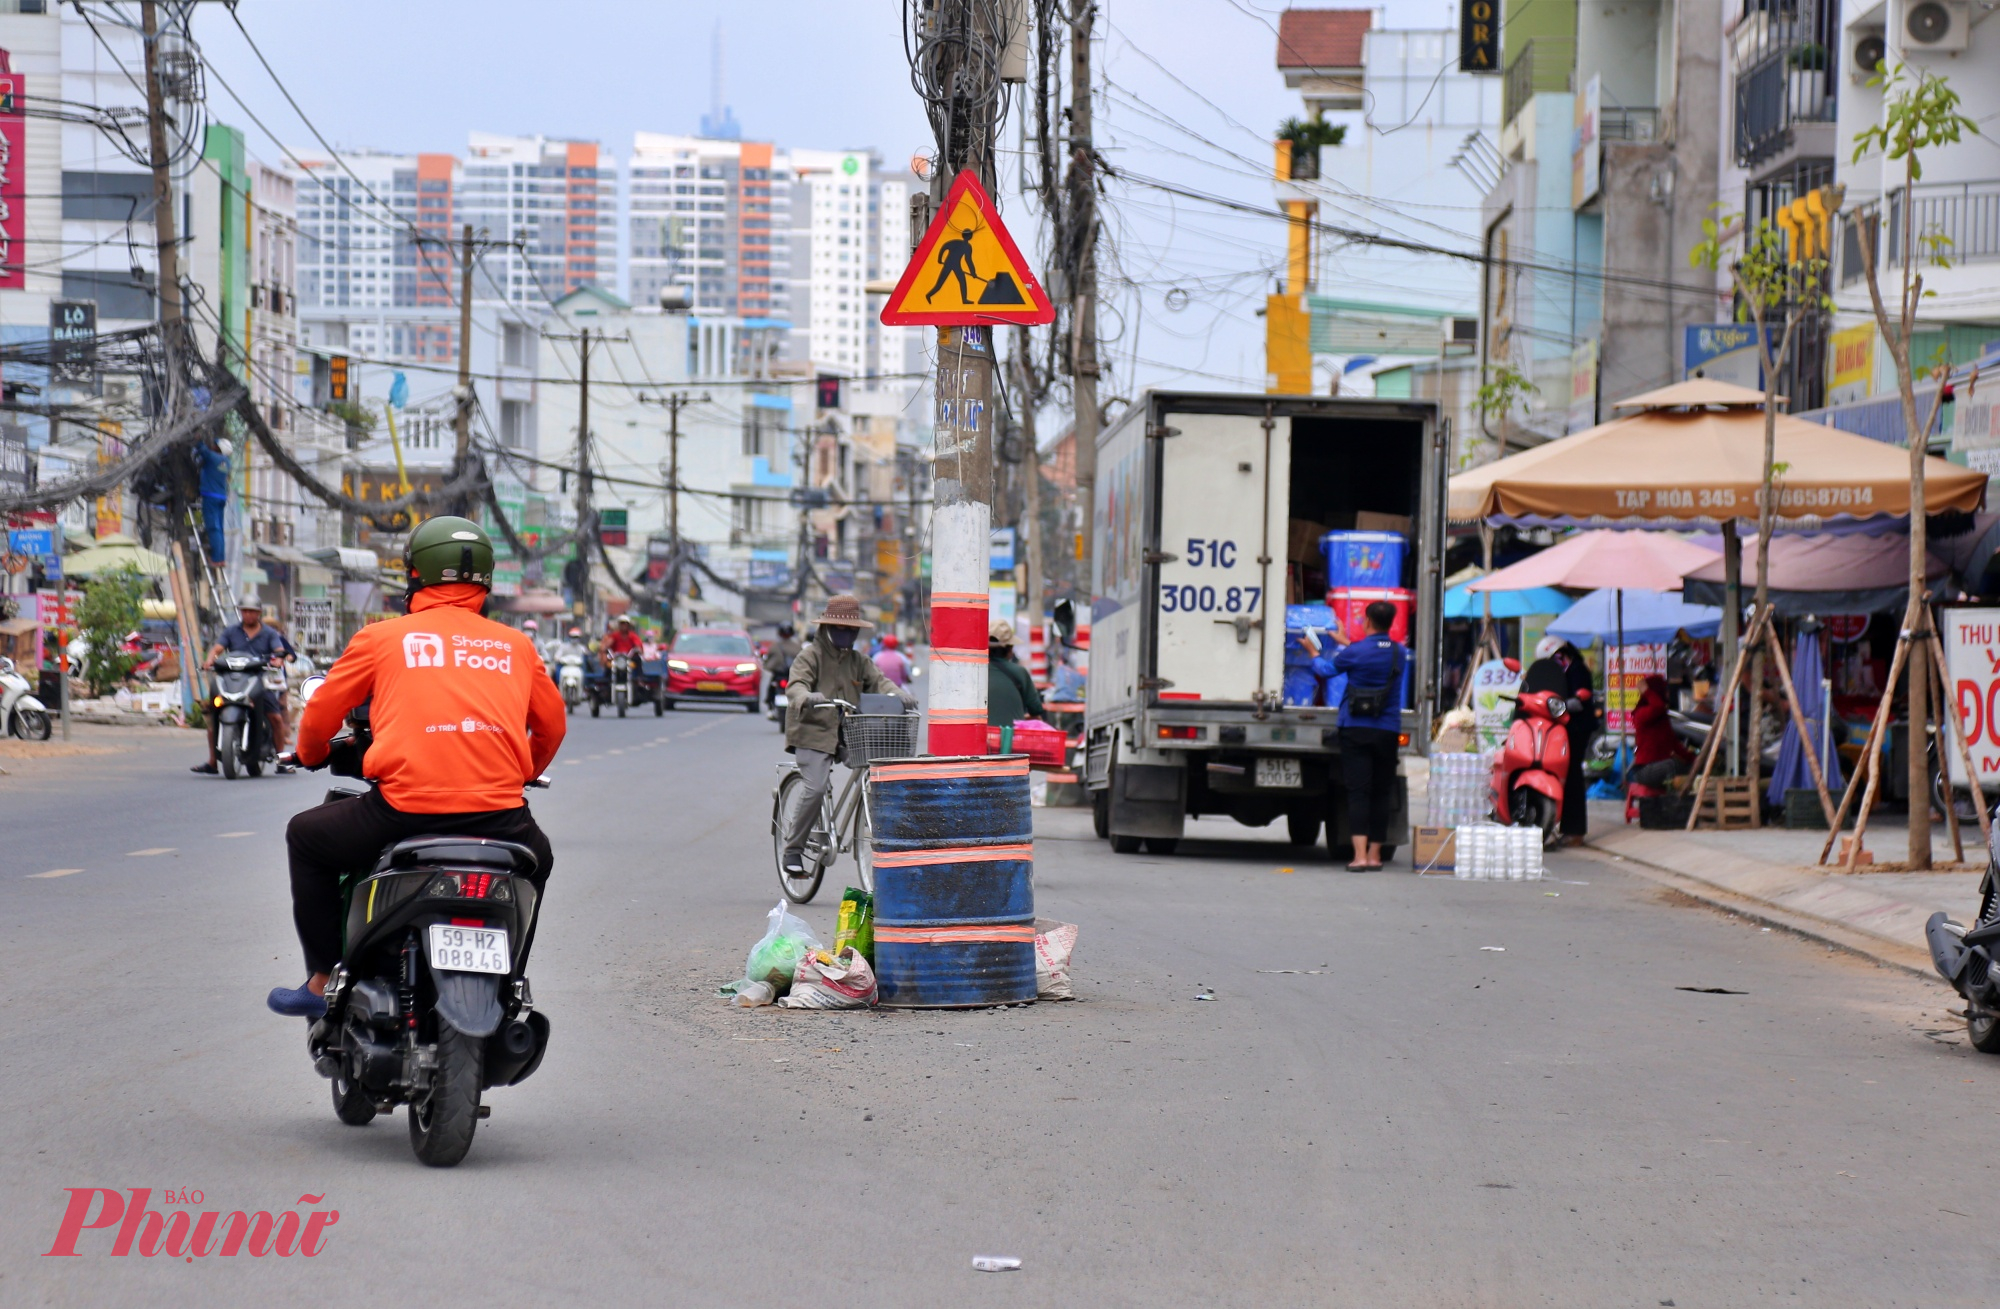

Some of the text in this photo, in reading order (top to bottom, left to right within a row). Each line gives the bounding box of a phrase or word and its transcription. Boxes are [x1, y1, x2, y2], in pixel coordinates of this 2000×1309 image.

[1715, 328, 1749, 347] Tiger
[1699, 488, 1736, 507] 345
[1187, 538, 1237, 568] 51C
[1161, 584, 1262, 613] 300.87
[452, 635, 512, 653] Shopee
[1959, 624, 1993, 645] THU
[454, 649, 511, 675] Food
[438, 724, 457, 732] TRÊN
[1266, 760, 1290, 772] 51C
[442, 929, 496, 951] 59-H2
[438, 948, 502, 971] 088.46
